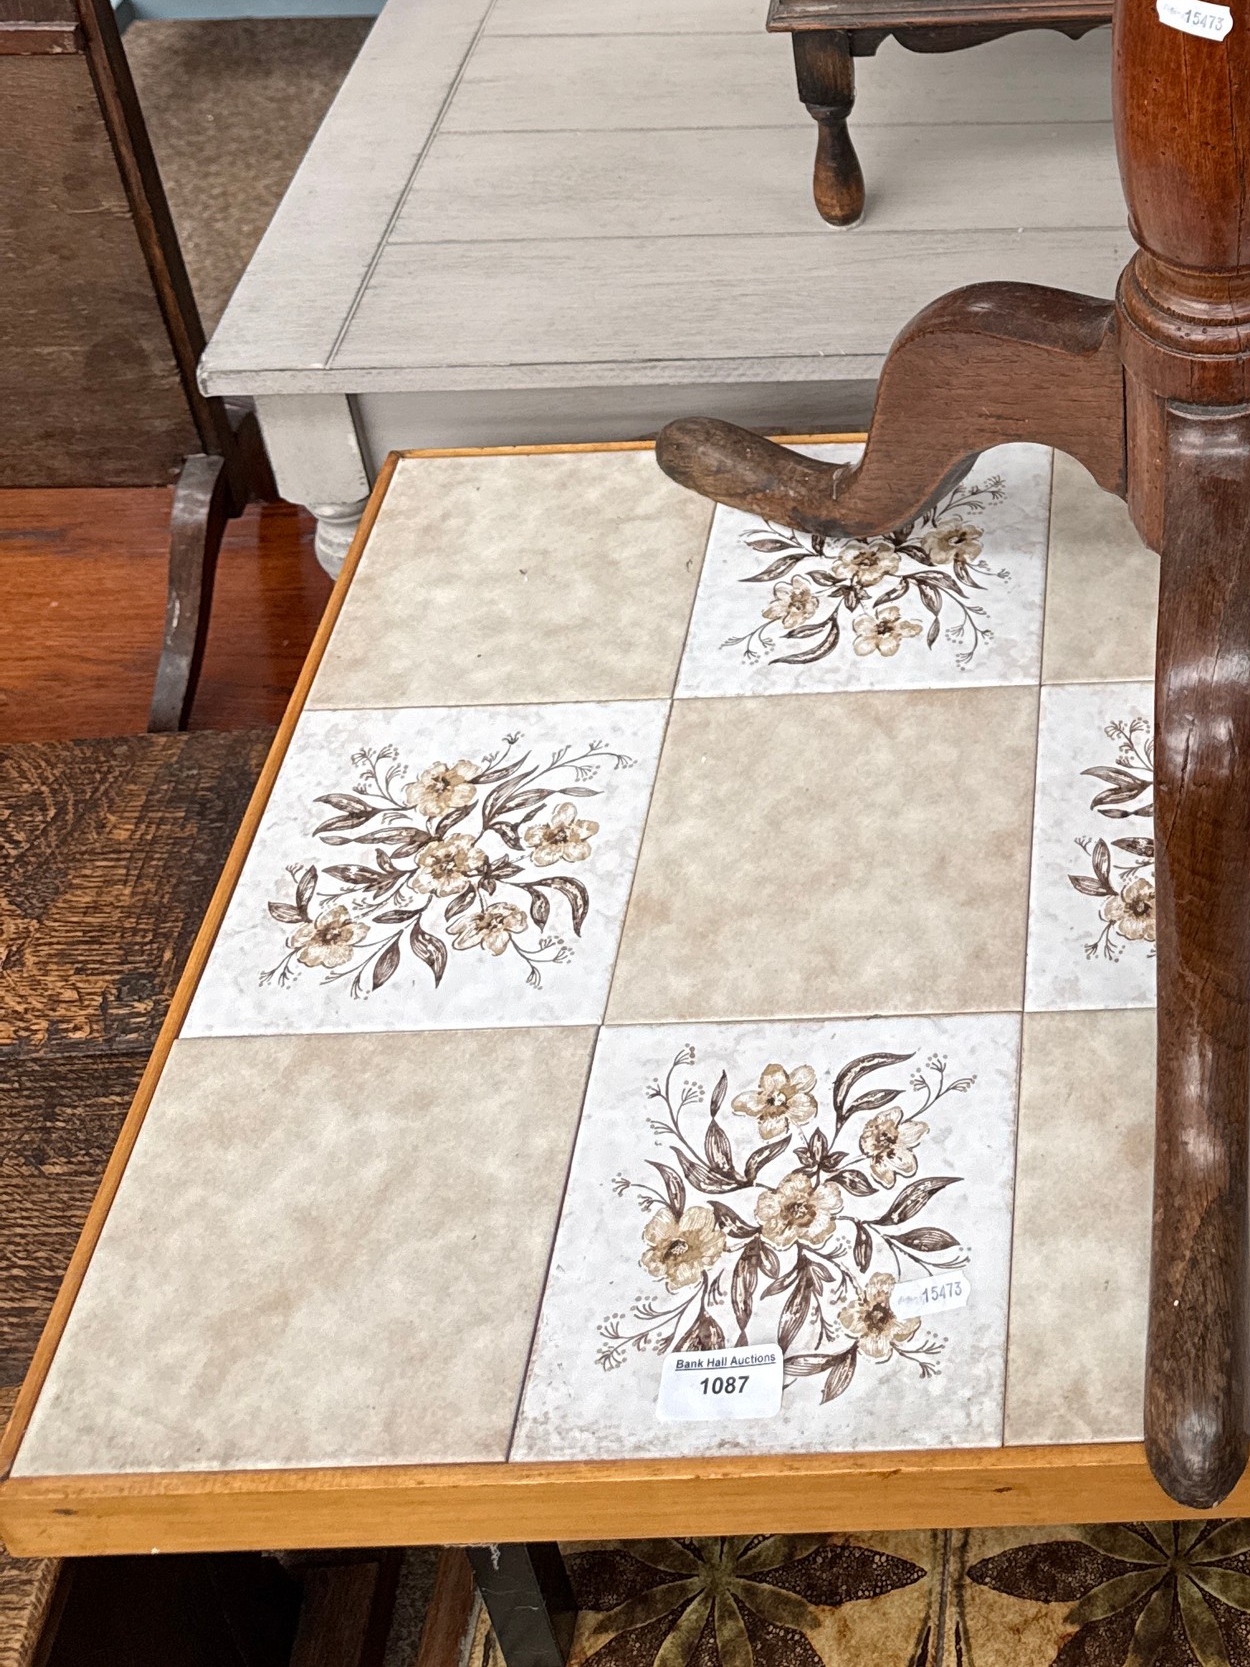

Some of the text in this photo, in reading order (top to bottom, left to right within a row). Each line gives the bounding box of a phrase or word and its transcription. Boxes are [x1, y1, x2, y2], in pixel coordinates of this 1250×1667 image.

[1185, 9, 1225, 31] 15473
[922, 1281, 962, 1303] 15473
[676, 1353, 776, 1369] Bank Hall Auctions
[700, 1375, 750, 1395] 1087
